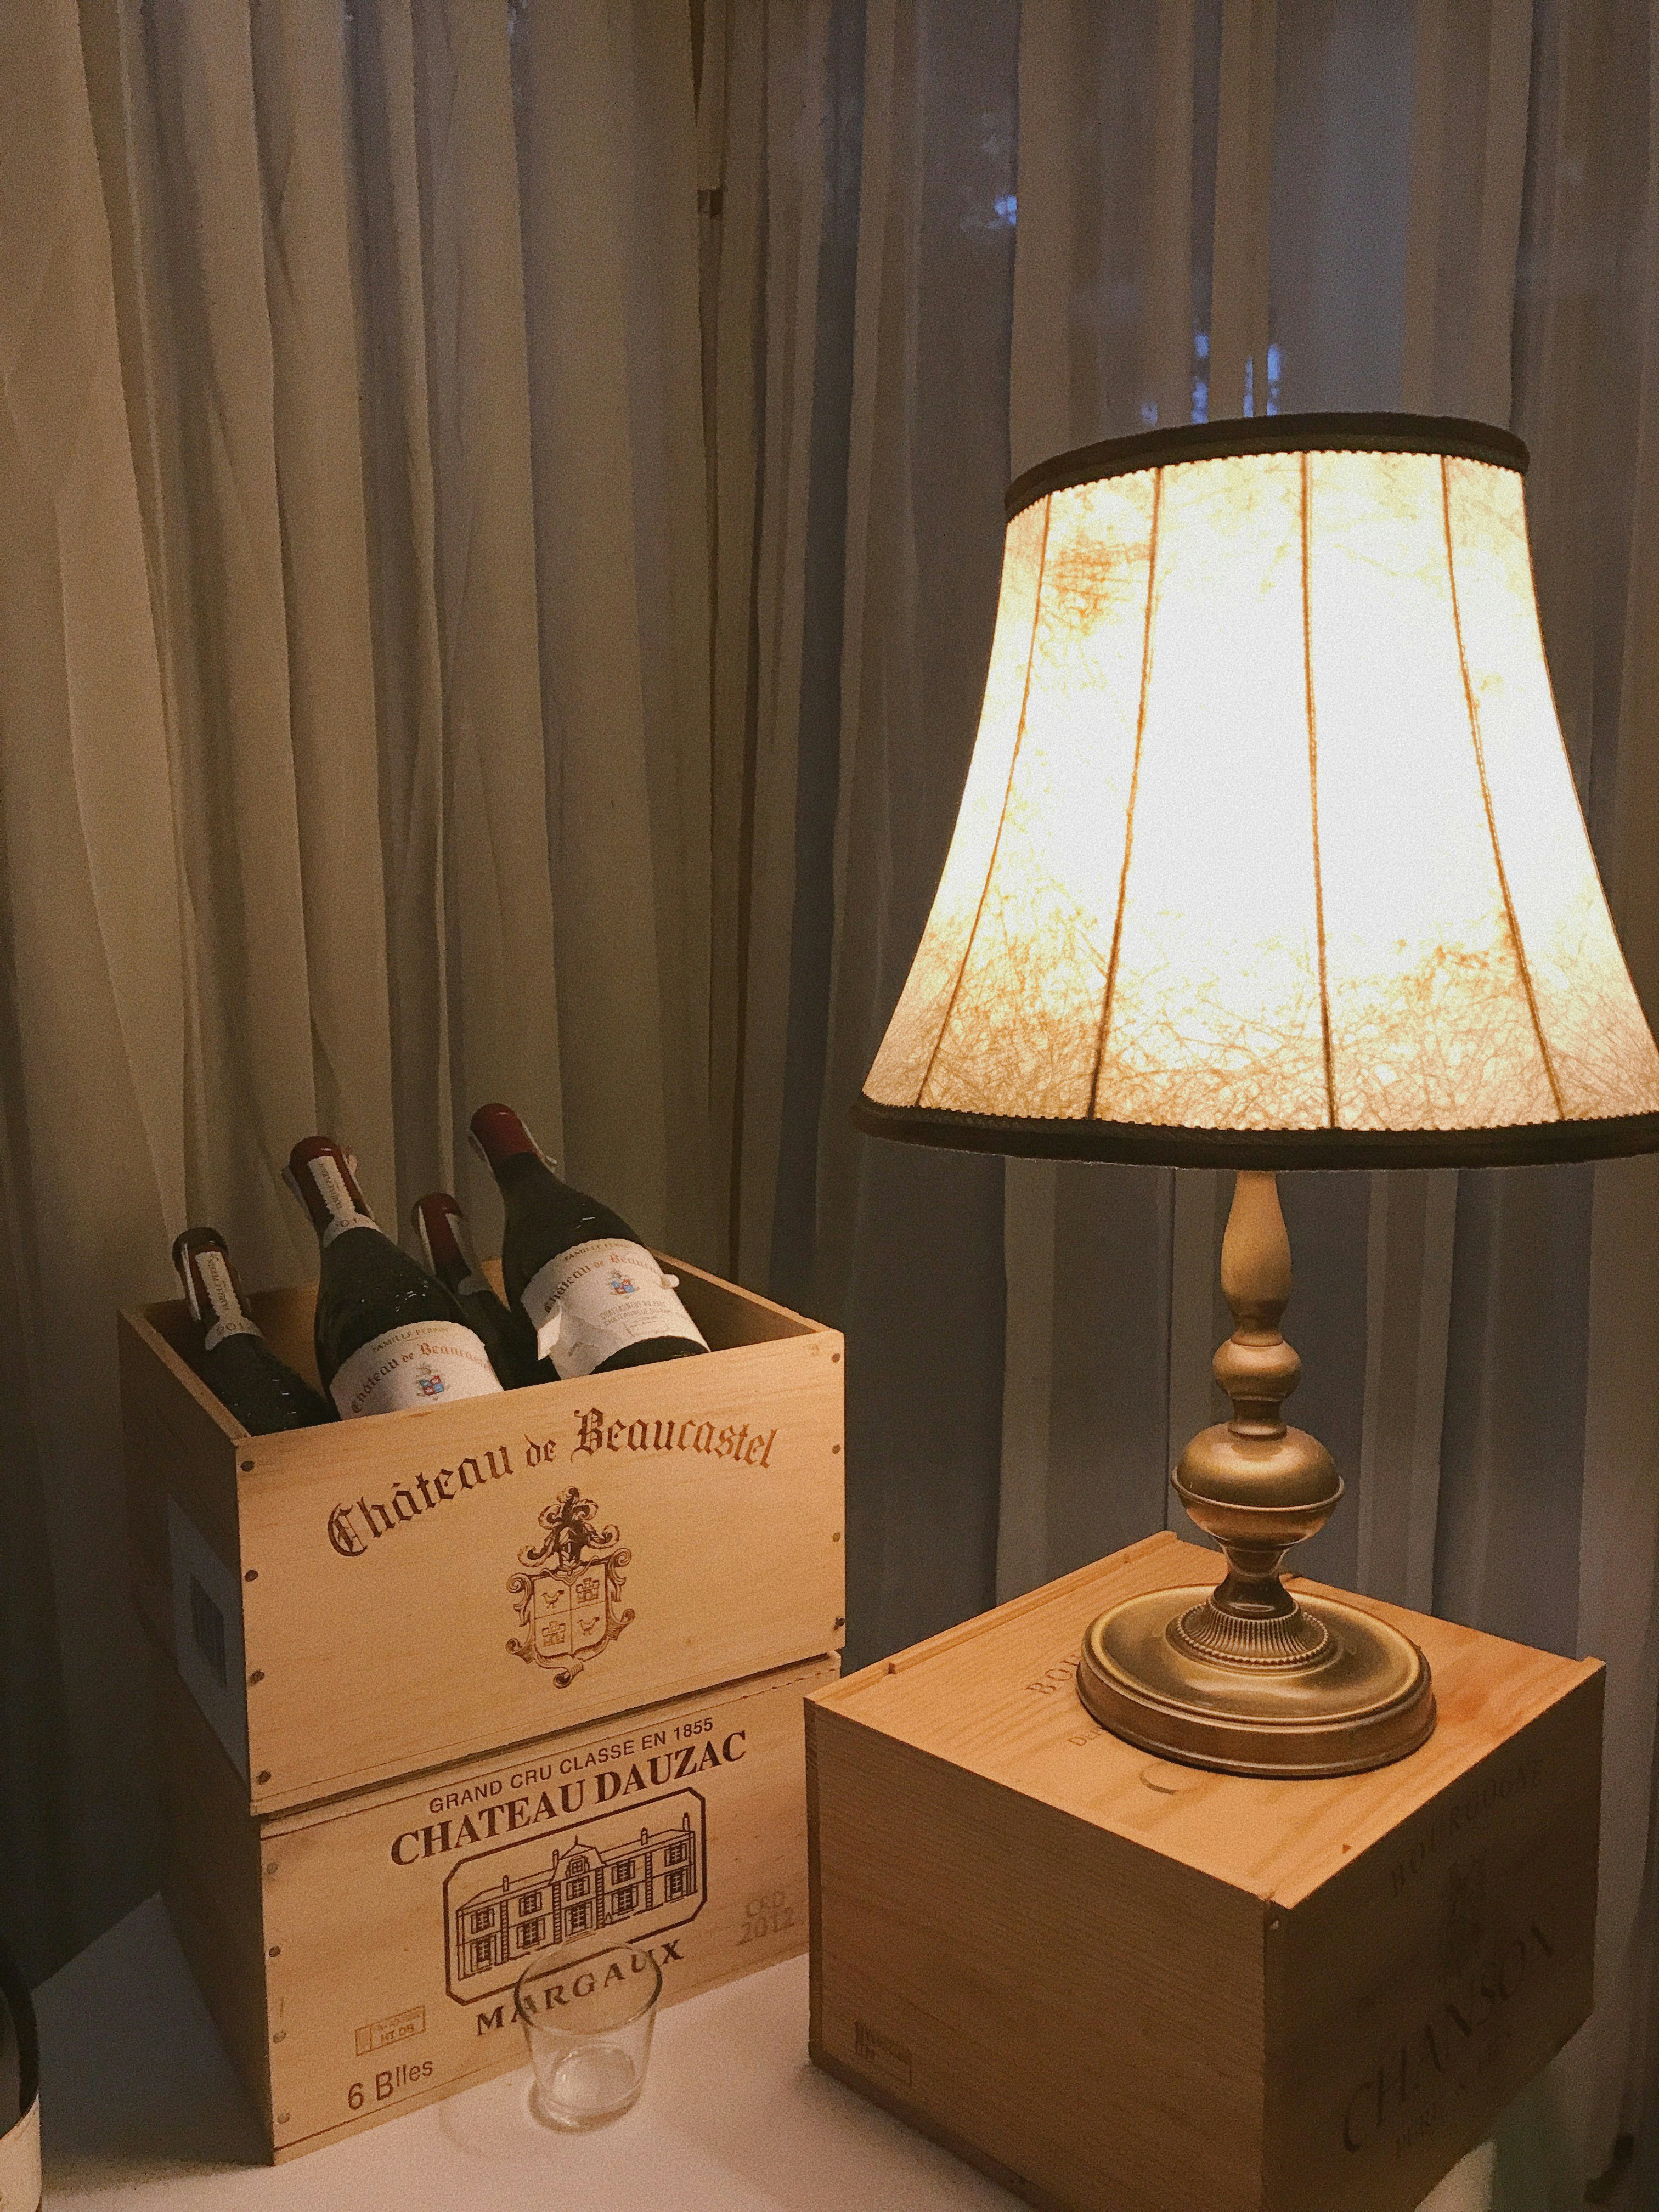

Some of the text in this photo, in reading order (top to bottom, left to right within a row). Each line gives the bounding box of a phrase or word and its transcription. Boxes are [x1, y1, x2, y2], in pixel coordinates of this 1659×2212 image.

[327, 1408, 778, 1557] Château de Beaucastel
[391, 1730, 747, 1865] CHATEAU DAUZAC
[429, 1718, 714, 1814] GRAND CRU CLASSE EN 1855
[735, 1907, 795, 1946] 2012
[476, 1939, 684, 2036] MARGAUX
[348, 2083, 364, 2110] 6
